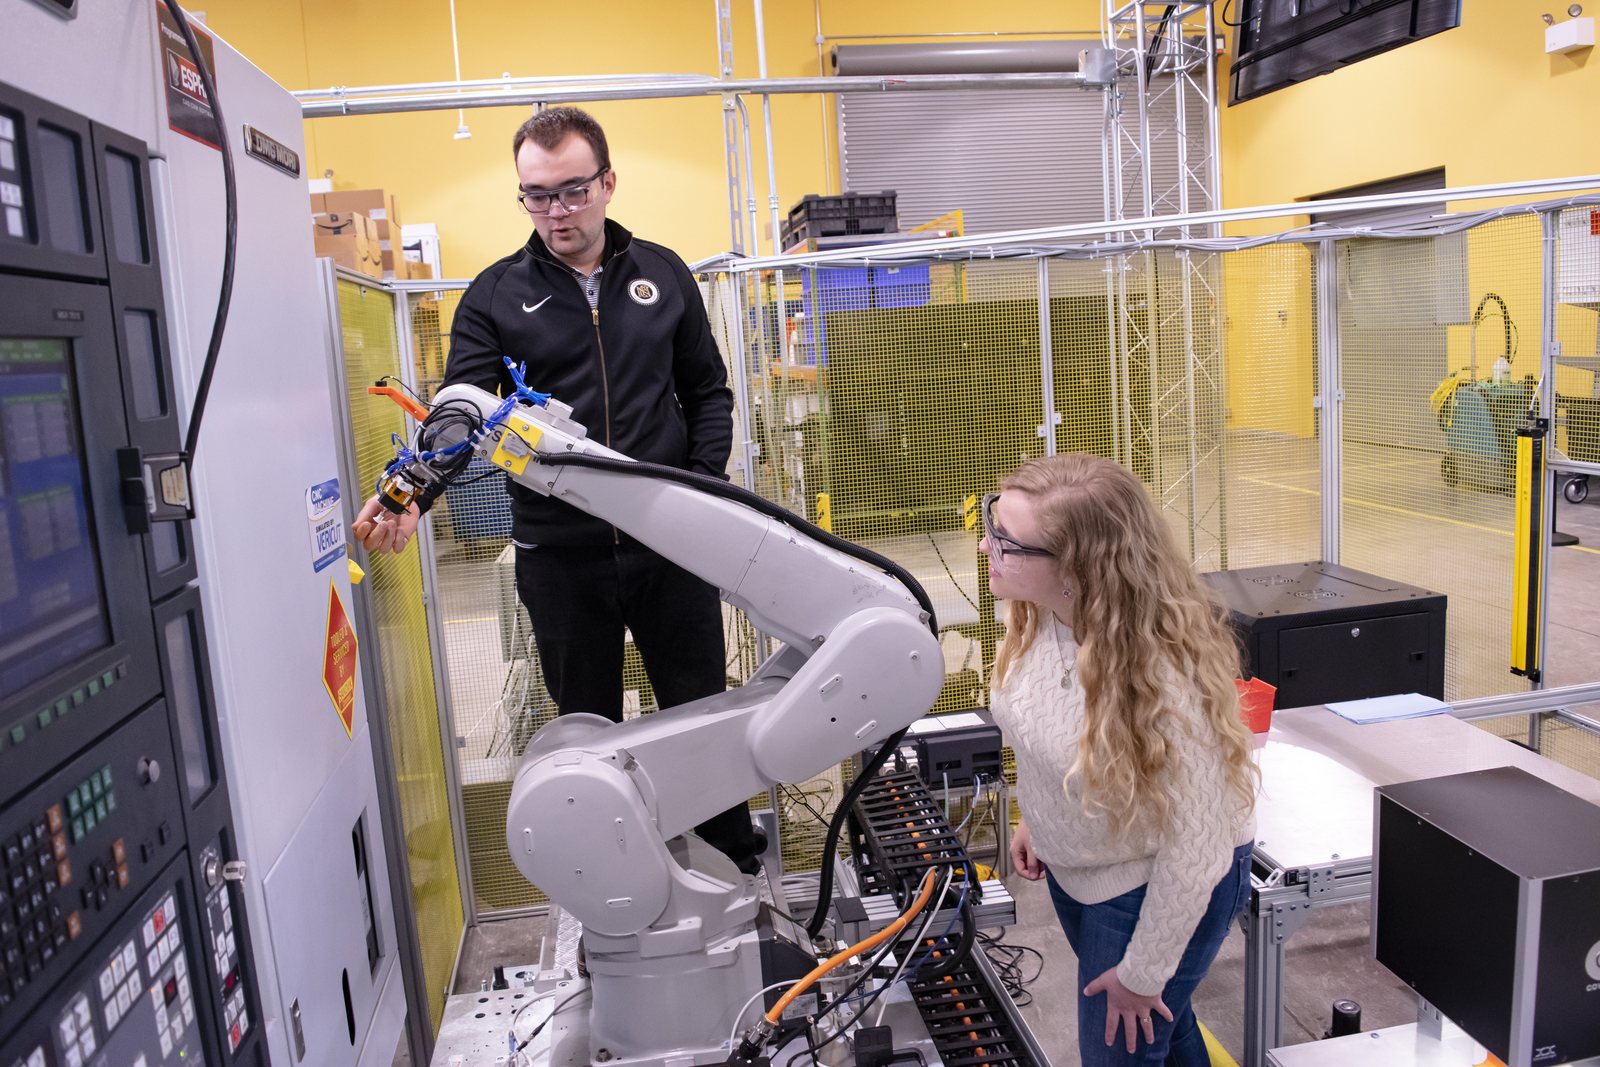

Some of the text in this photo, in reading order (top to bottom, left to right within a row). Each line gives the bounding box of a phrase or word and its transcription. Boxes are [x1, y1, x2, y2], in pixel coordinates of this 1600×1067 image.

[161, 22, 188, 47] Programme
[180, 63, 208, 99] ESPR
[256, 133, 296, 170] DMG MORI
[312, 488, 322, 502] CNC
[317, 524, 341, 552] VERICUT
[333, 640, 349, 666] SERVICED
